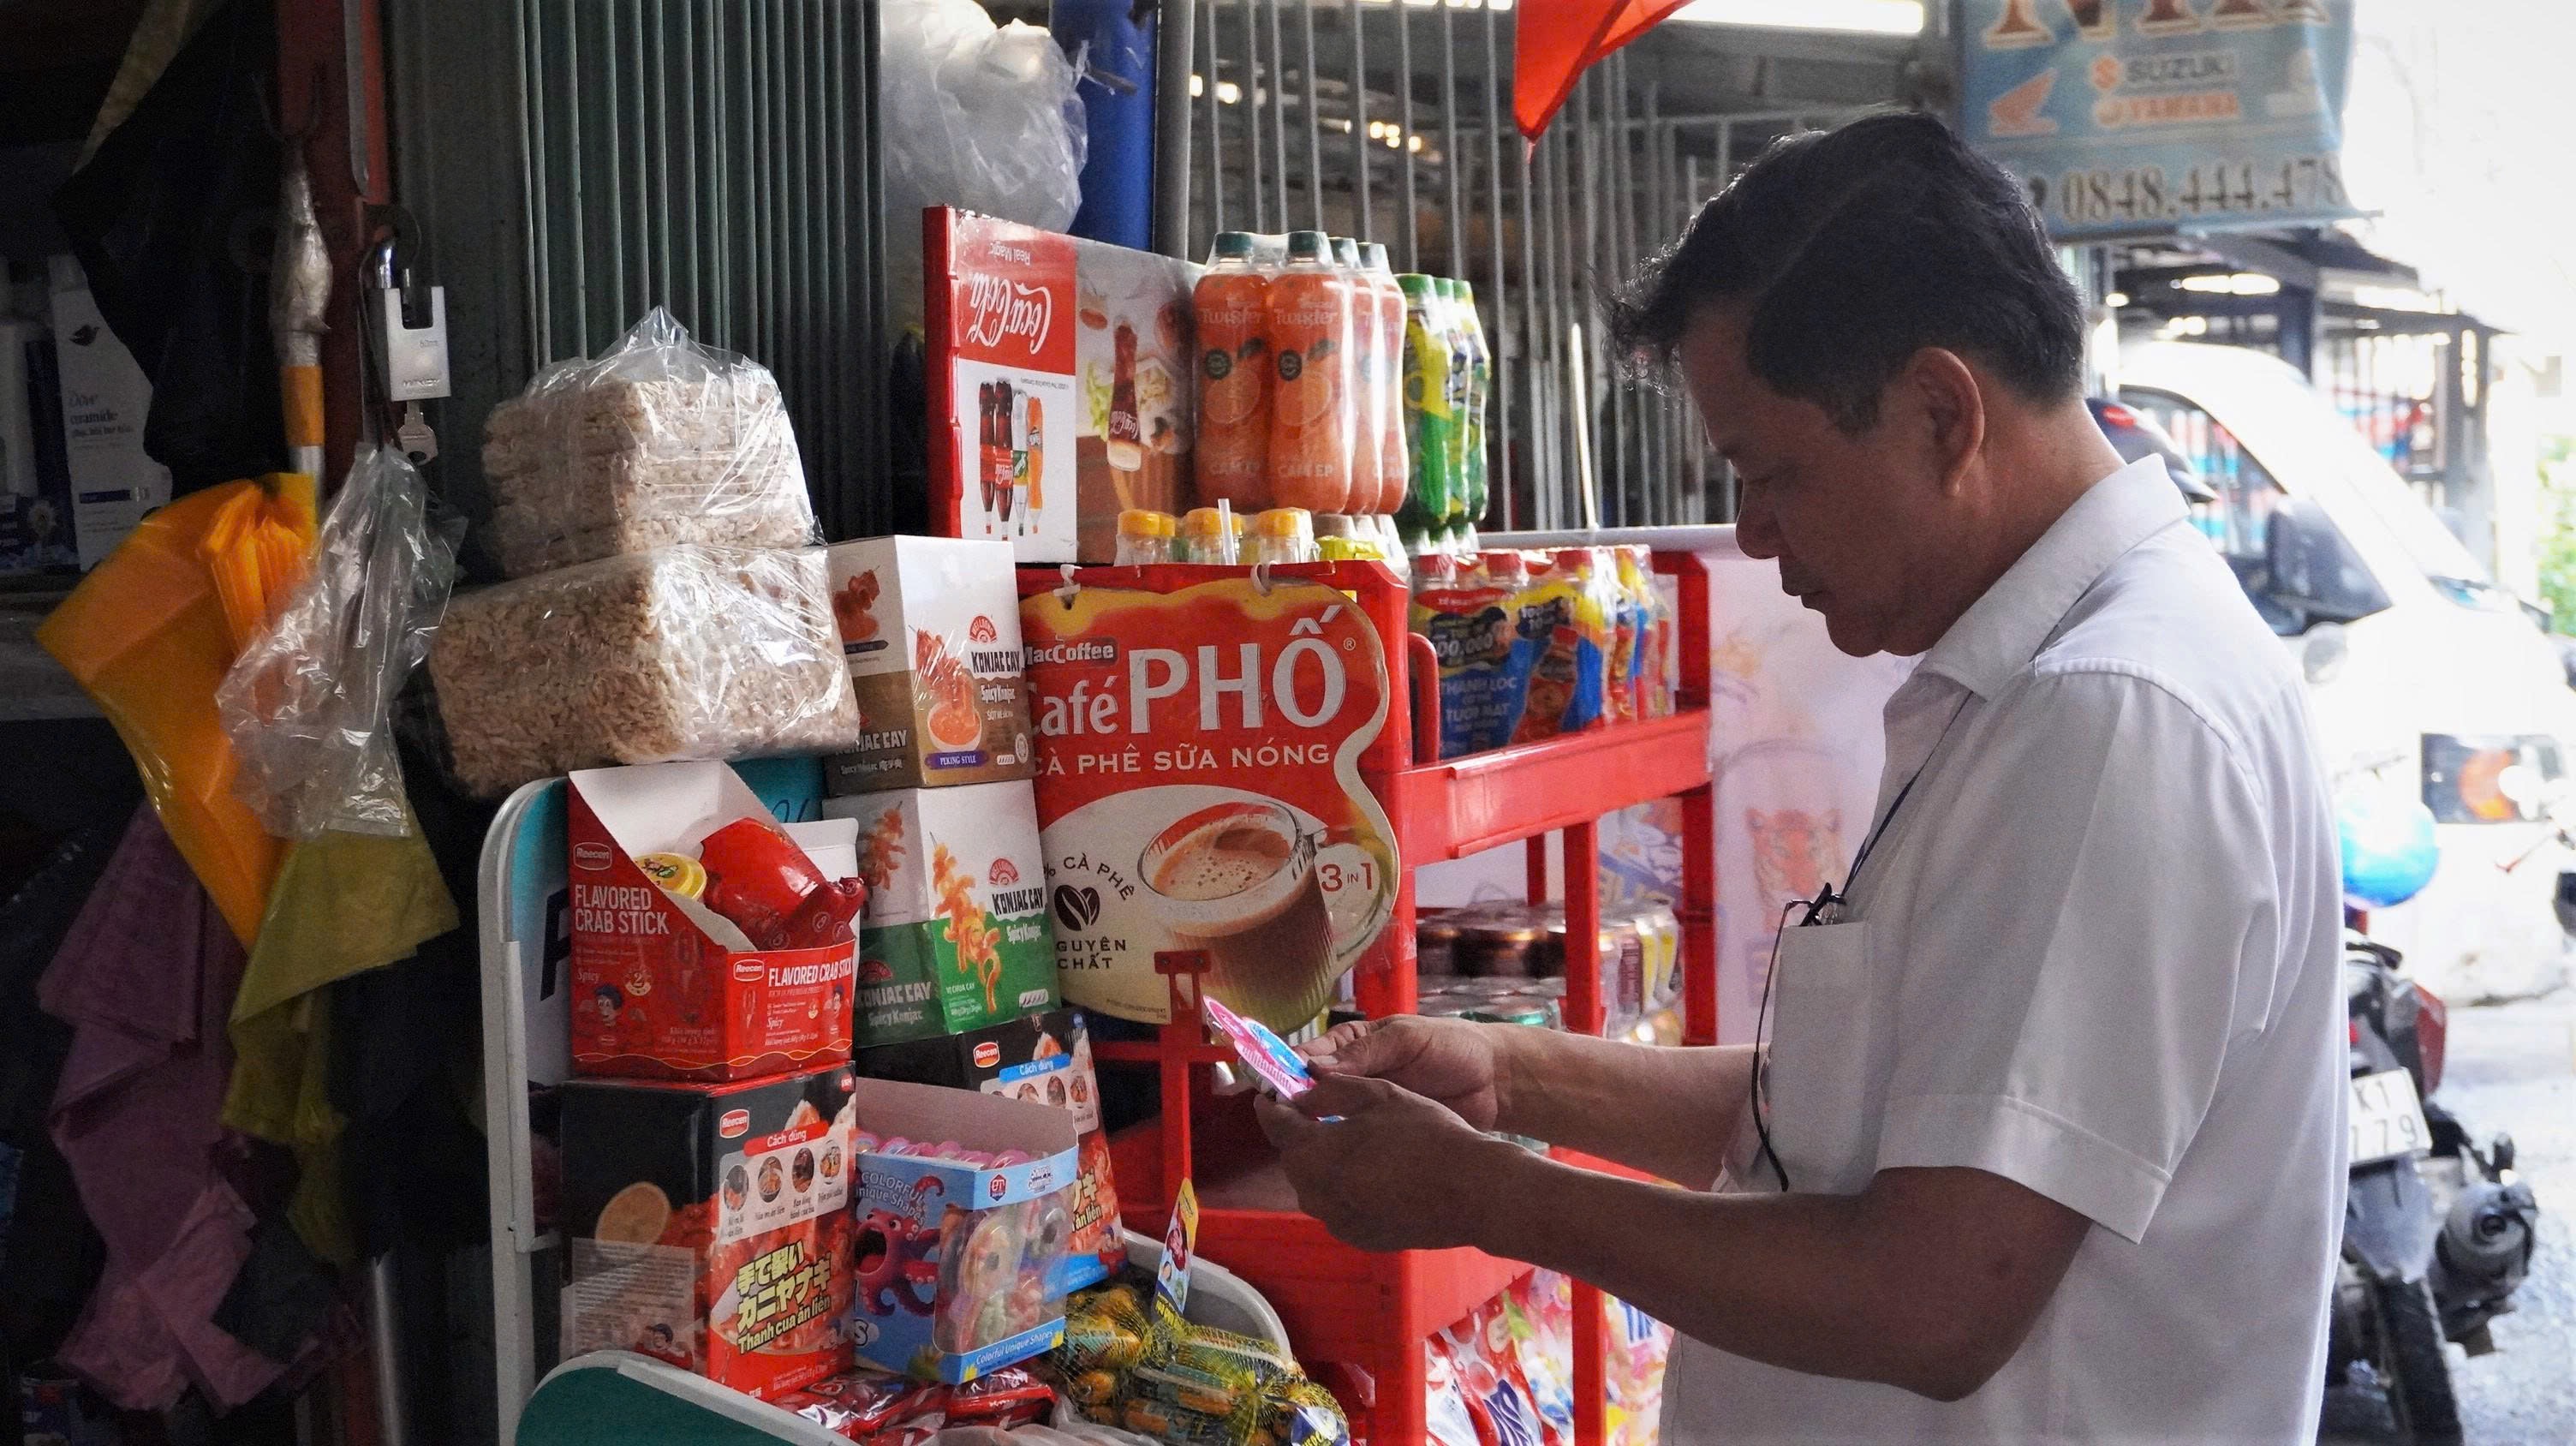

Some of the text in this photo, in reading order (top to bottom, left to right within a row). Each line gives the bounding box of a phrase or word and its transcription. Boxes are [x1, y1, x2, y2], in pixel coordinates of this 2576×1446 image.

[1014, 249, 1031, 266] Real
[966, 272, 1052, 355] Coca-Cola
[971, 651, 1020, 673] KONJAC CAY
[1129, 605, 1346, 733] PHỐ
[884, 730, 907, 748] CAY
[939, 755, 976, 765] PEKING STYLE
[1078, 743, 1141, 774] PHÊ
[1154, 744, 1218, 771] SỮA
[1232, 737, 1329, 768] NÓNG
[1063, 853, 1090, 871] CÀ
[1097, 863, 1135, 901] PHÊ
[1321, 863, 1372, 892] 3 IN 1
[575, 884, 652, 911] FLAVORED
[992, 887, 1043, 916] KONJAC CAY
[575, 908, 671, 935] CRAB STICK
[768, 965, 819, 988] FLAVORED
[819, 961, 839, 983] CRAB
[838, 957, 853, 978] STICK
[1058, 953, 1112, 970] CHẤT
[577, 967, 599, 984] Spicy
[904, 981, 932, 1002] CAY
[766, 1017, 784, 1030] Spicy
[1019, 1064, 1037, 1076] Cách
[767, 1129, 807, 1148] Cách dùng
[862, 1171, 926, 1205] COLORFUL
[890, 1192, 926, 1228] Shapes
[737, 1293, 831, 1354] Thanh cua ăn liền
[976, 1330, 1053, 1365] Colorful Unique Shapes
